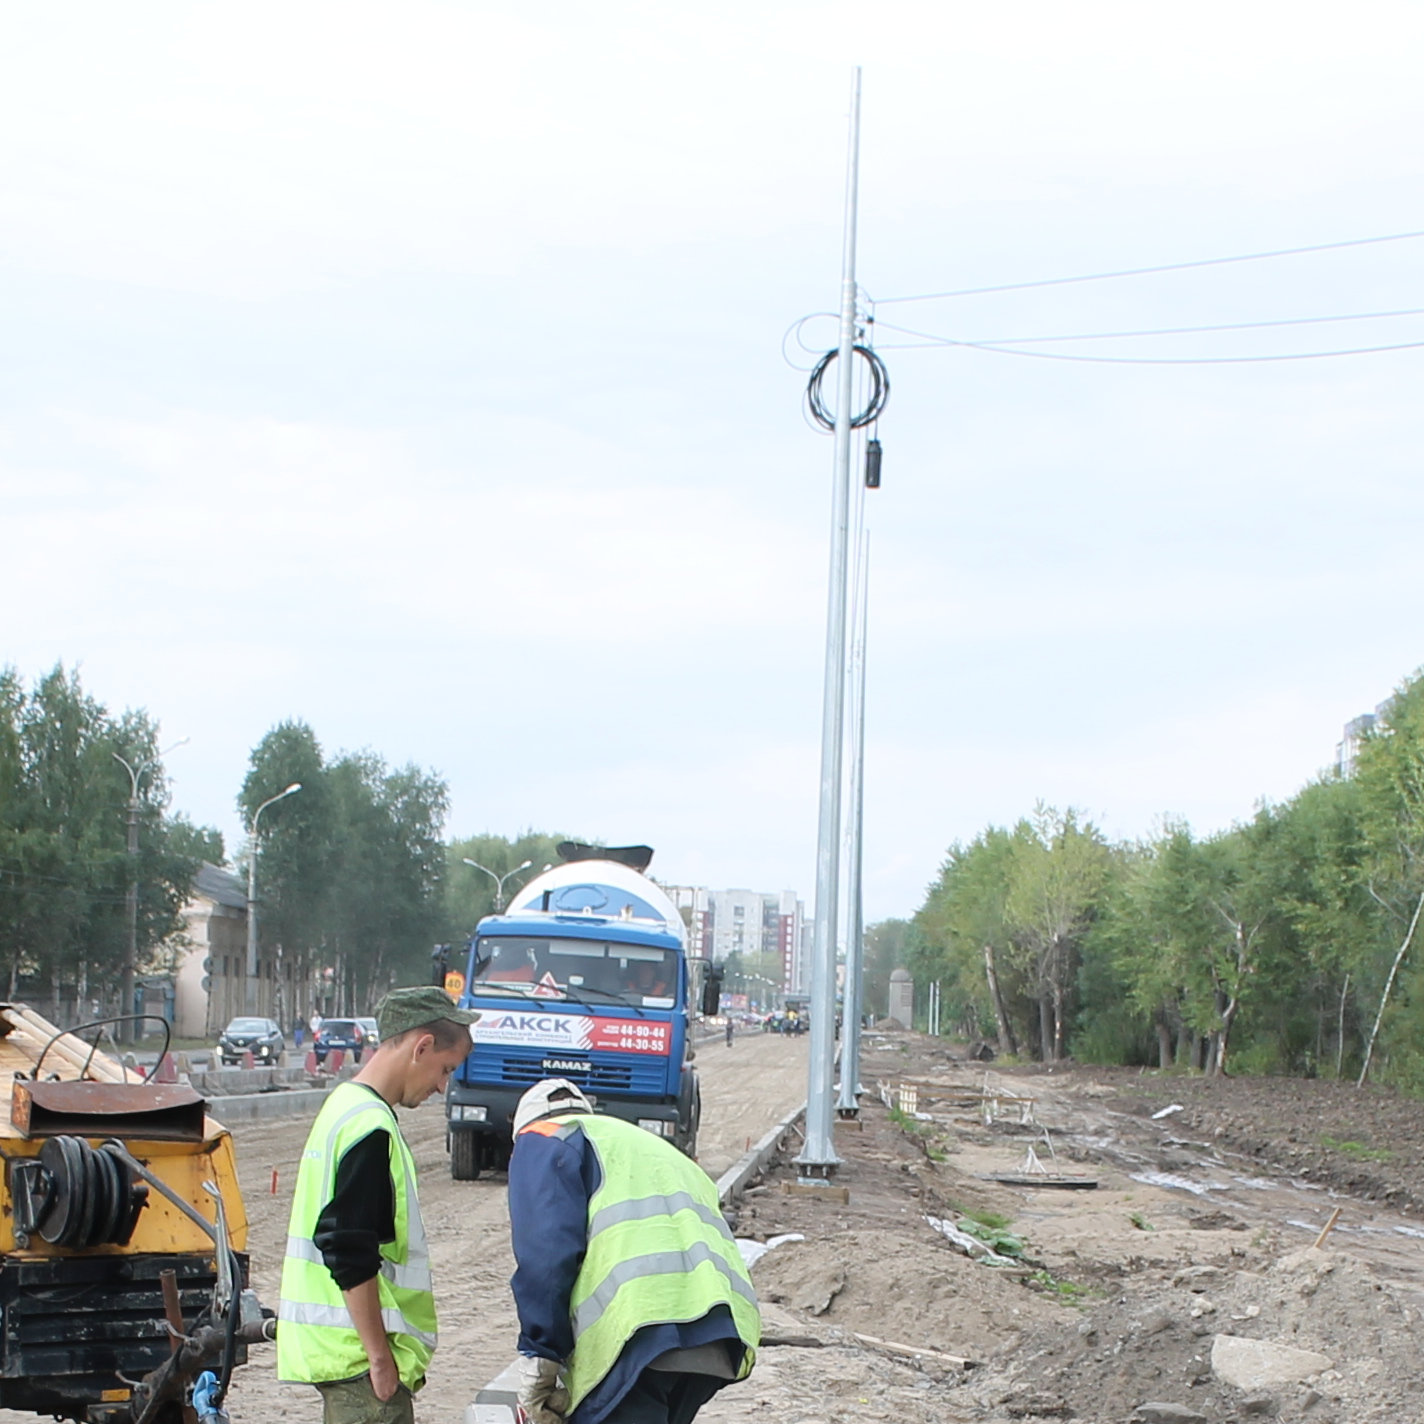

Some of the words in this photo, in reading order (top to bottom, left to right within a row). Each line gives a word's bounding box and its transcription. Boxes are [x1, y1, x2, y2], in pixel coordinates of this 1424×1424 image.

[447, 978, 462, 989] 40
[499, 1015, 573, 1034] АКСК
[621, 1025, 665, 1038] 44-90-44
[620, 1037, 664, 1051] 44-30-55
[542, 1059, 592, 1071] KAMAZ
